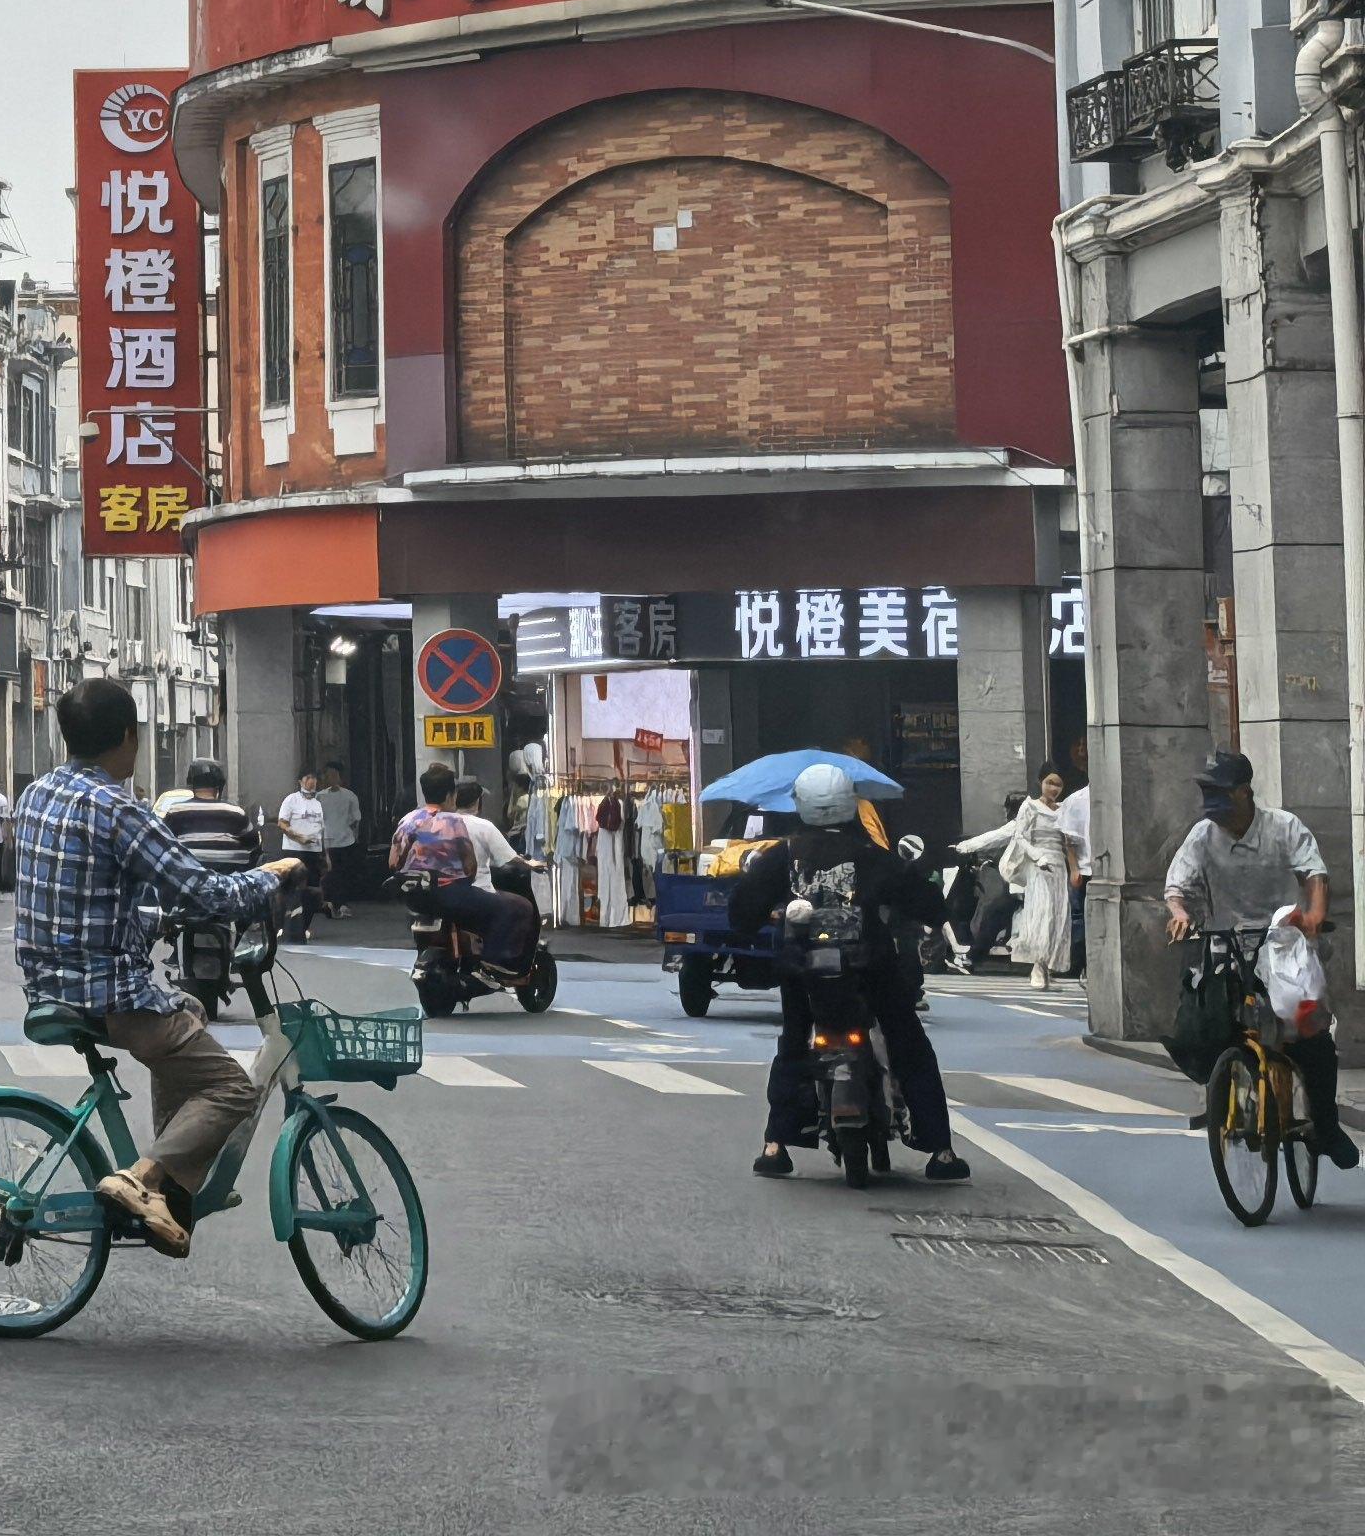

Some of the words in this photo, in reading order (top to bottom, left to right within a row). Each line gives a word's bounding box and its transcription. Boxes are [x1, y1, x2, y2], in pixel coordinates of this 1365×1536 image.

[122, 107, 164, 133] YC
[100, 169, 175, 465] 悦橙酒店
[98, 484, 191, 533] 客房
[734, 590, 958, 658] 悦橙美宿
